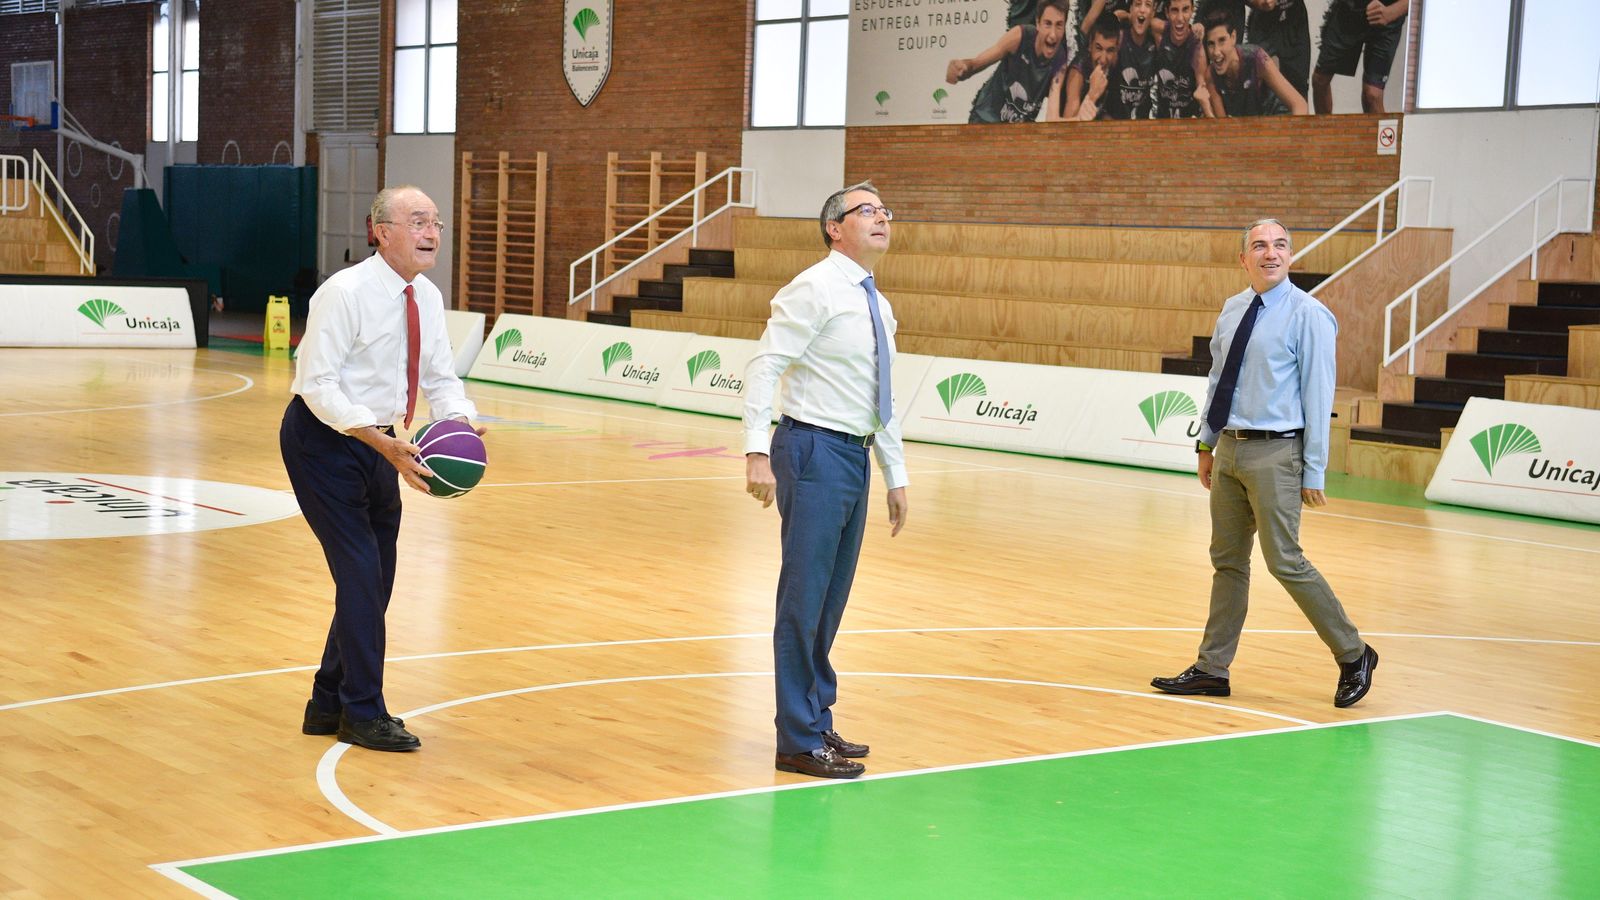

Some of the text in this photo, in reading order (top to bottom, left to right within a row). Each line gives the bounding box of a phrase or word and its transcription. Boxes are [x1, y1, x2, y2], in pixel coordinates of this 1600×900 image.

[862, 9, 989, 32] ENTREGA TRABAJO
[898, 34, 948, 51] EQUIPO
[572, 46, 599, 61] Unicaja
[125, 316, 181, 333] Unicaja
[512, 349, 548, 368] Unicaja
[622, 364, 661, 385] Unicaja
[975, 400, 1038, 425] Unicaja
